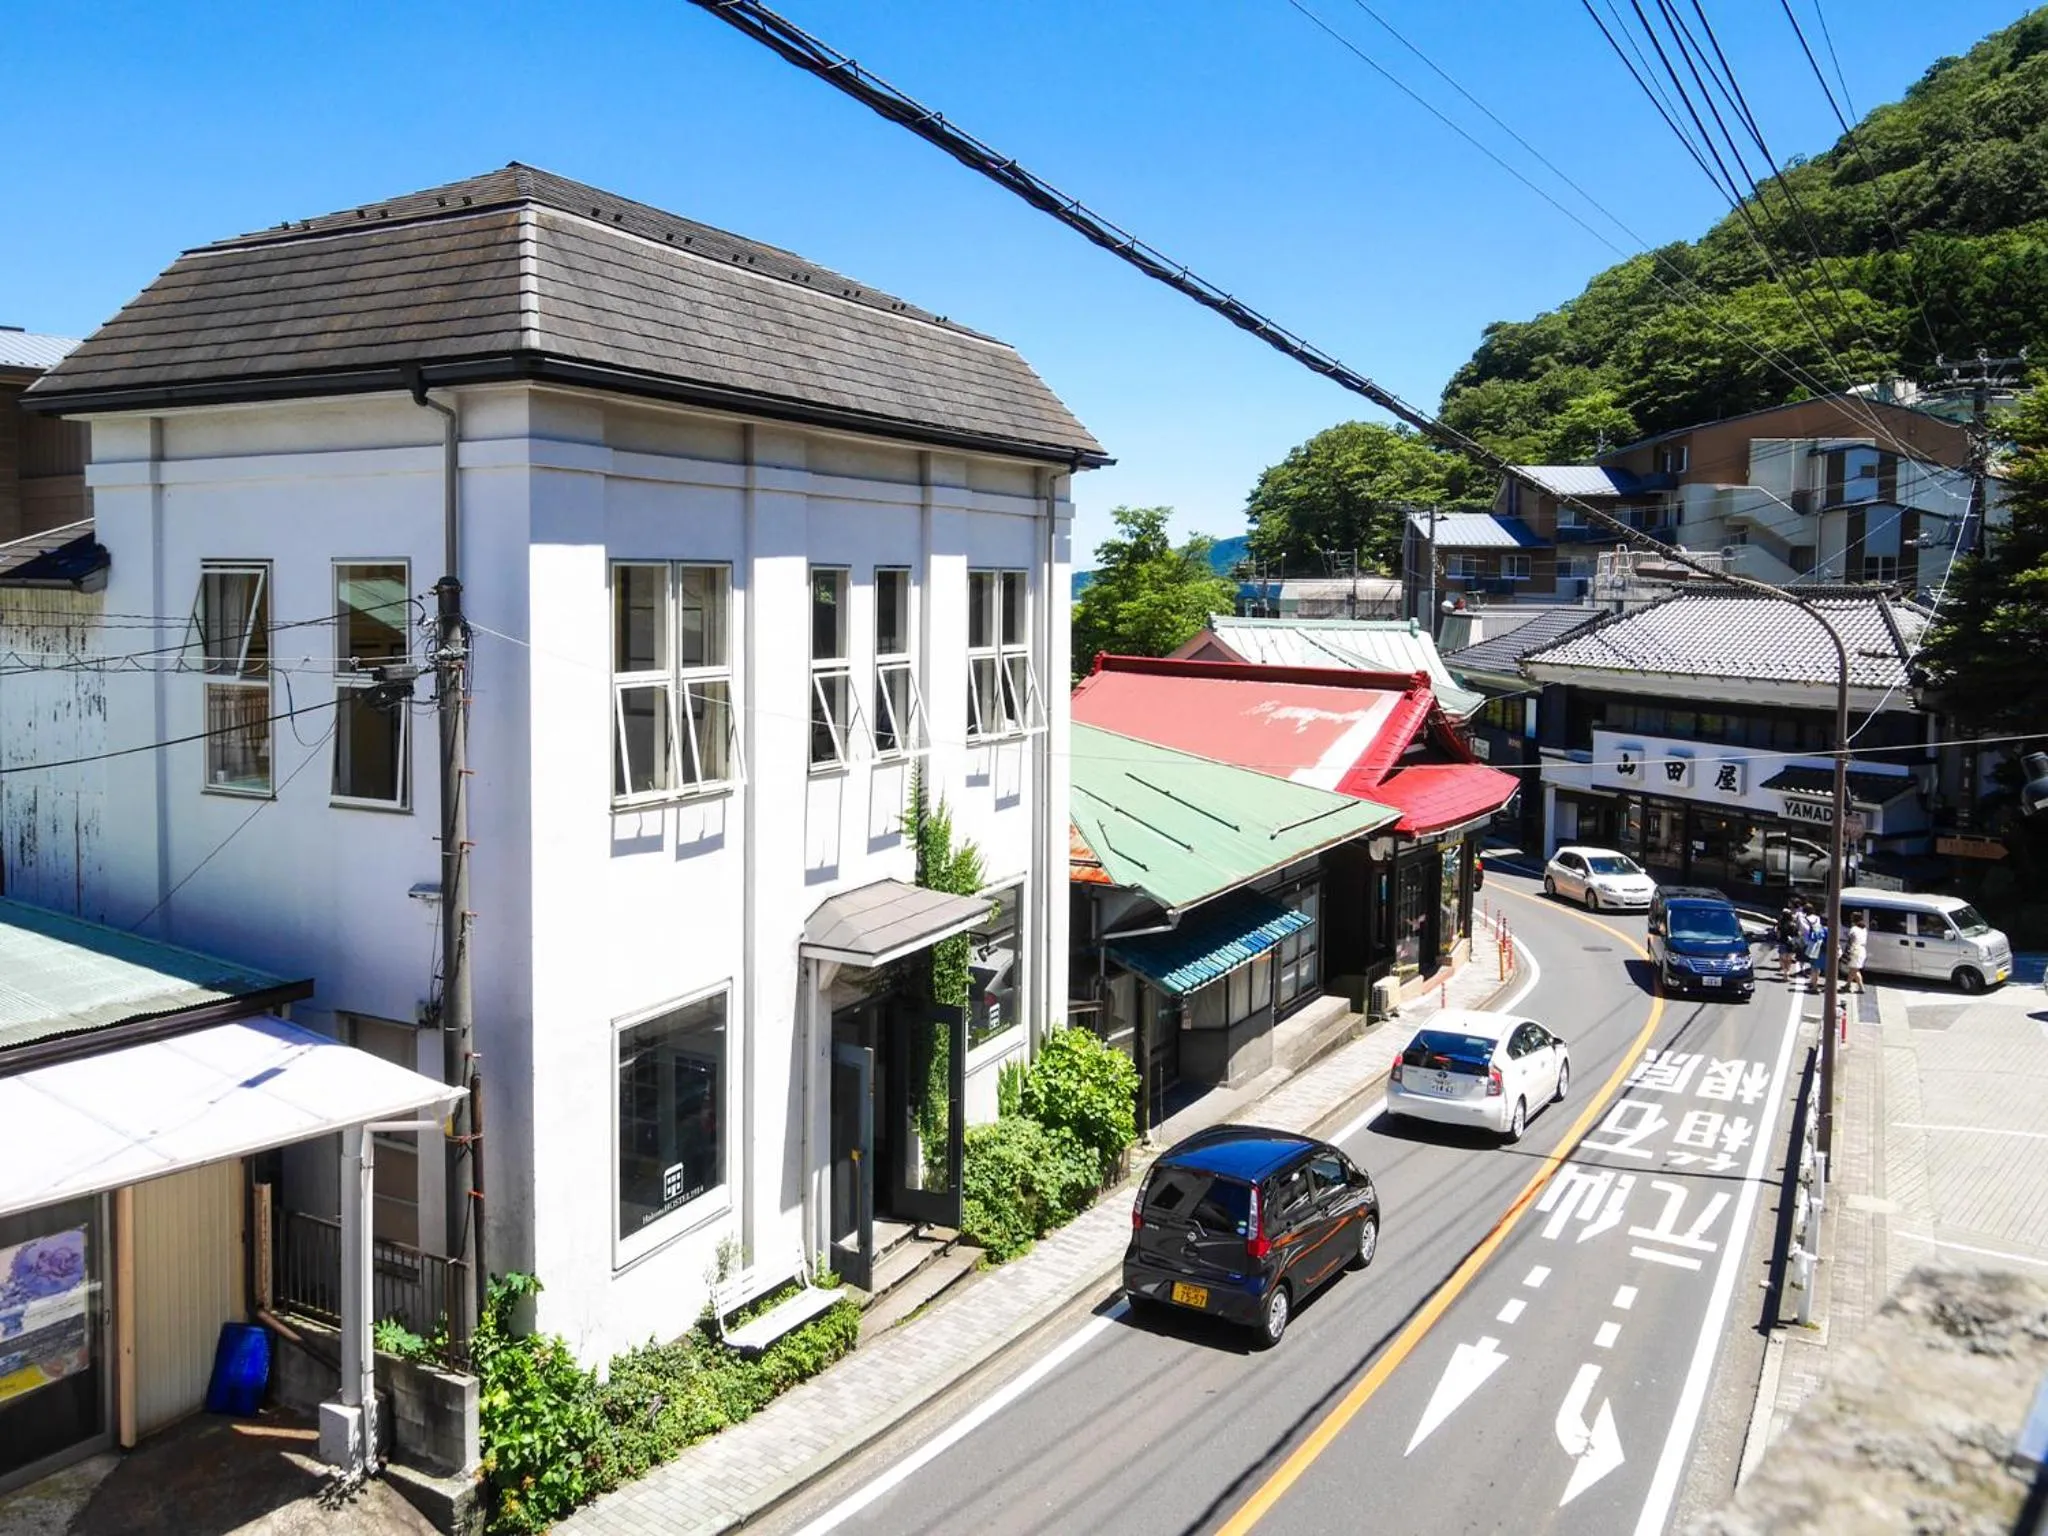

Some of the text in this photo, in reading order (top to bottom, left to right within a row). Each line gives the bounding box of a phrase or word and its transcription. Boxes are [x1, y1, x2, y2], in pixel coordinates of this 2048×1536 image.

[1616, 752, 1738, 793] 山田屋
[1784, 800, 1834, 823] YAMAD
[1627, 1057, 1771, 1271] 元箱根
